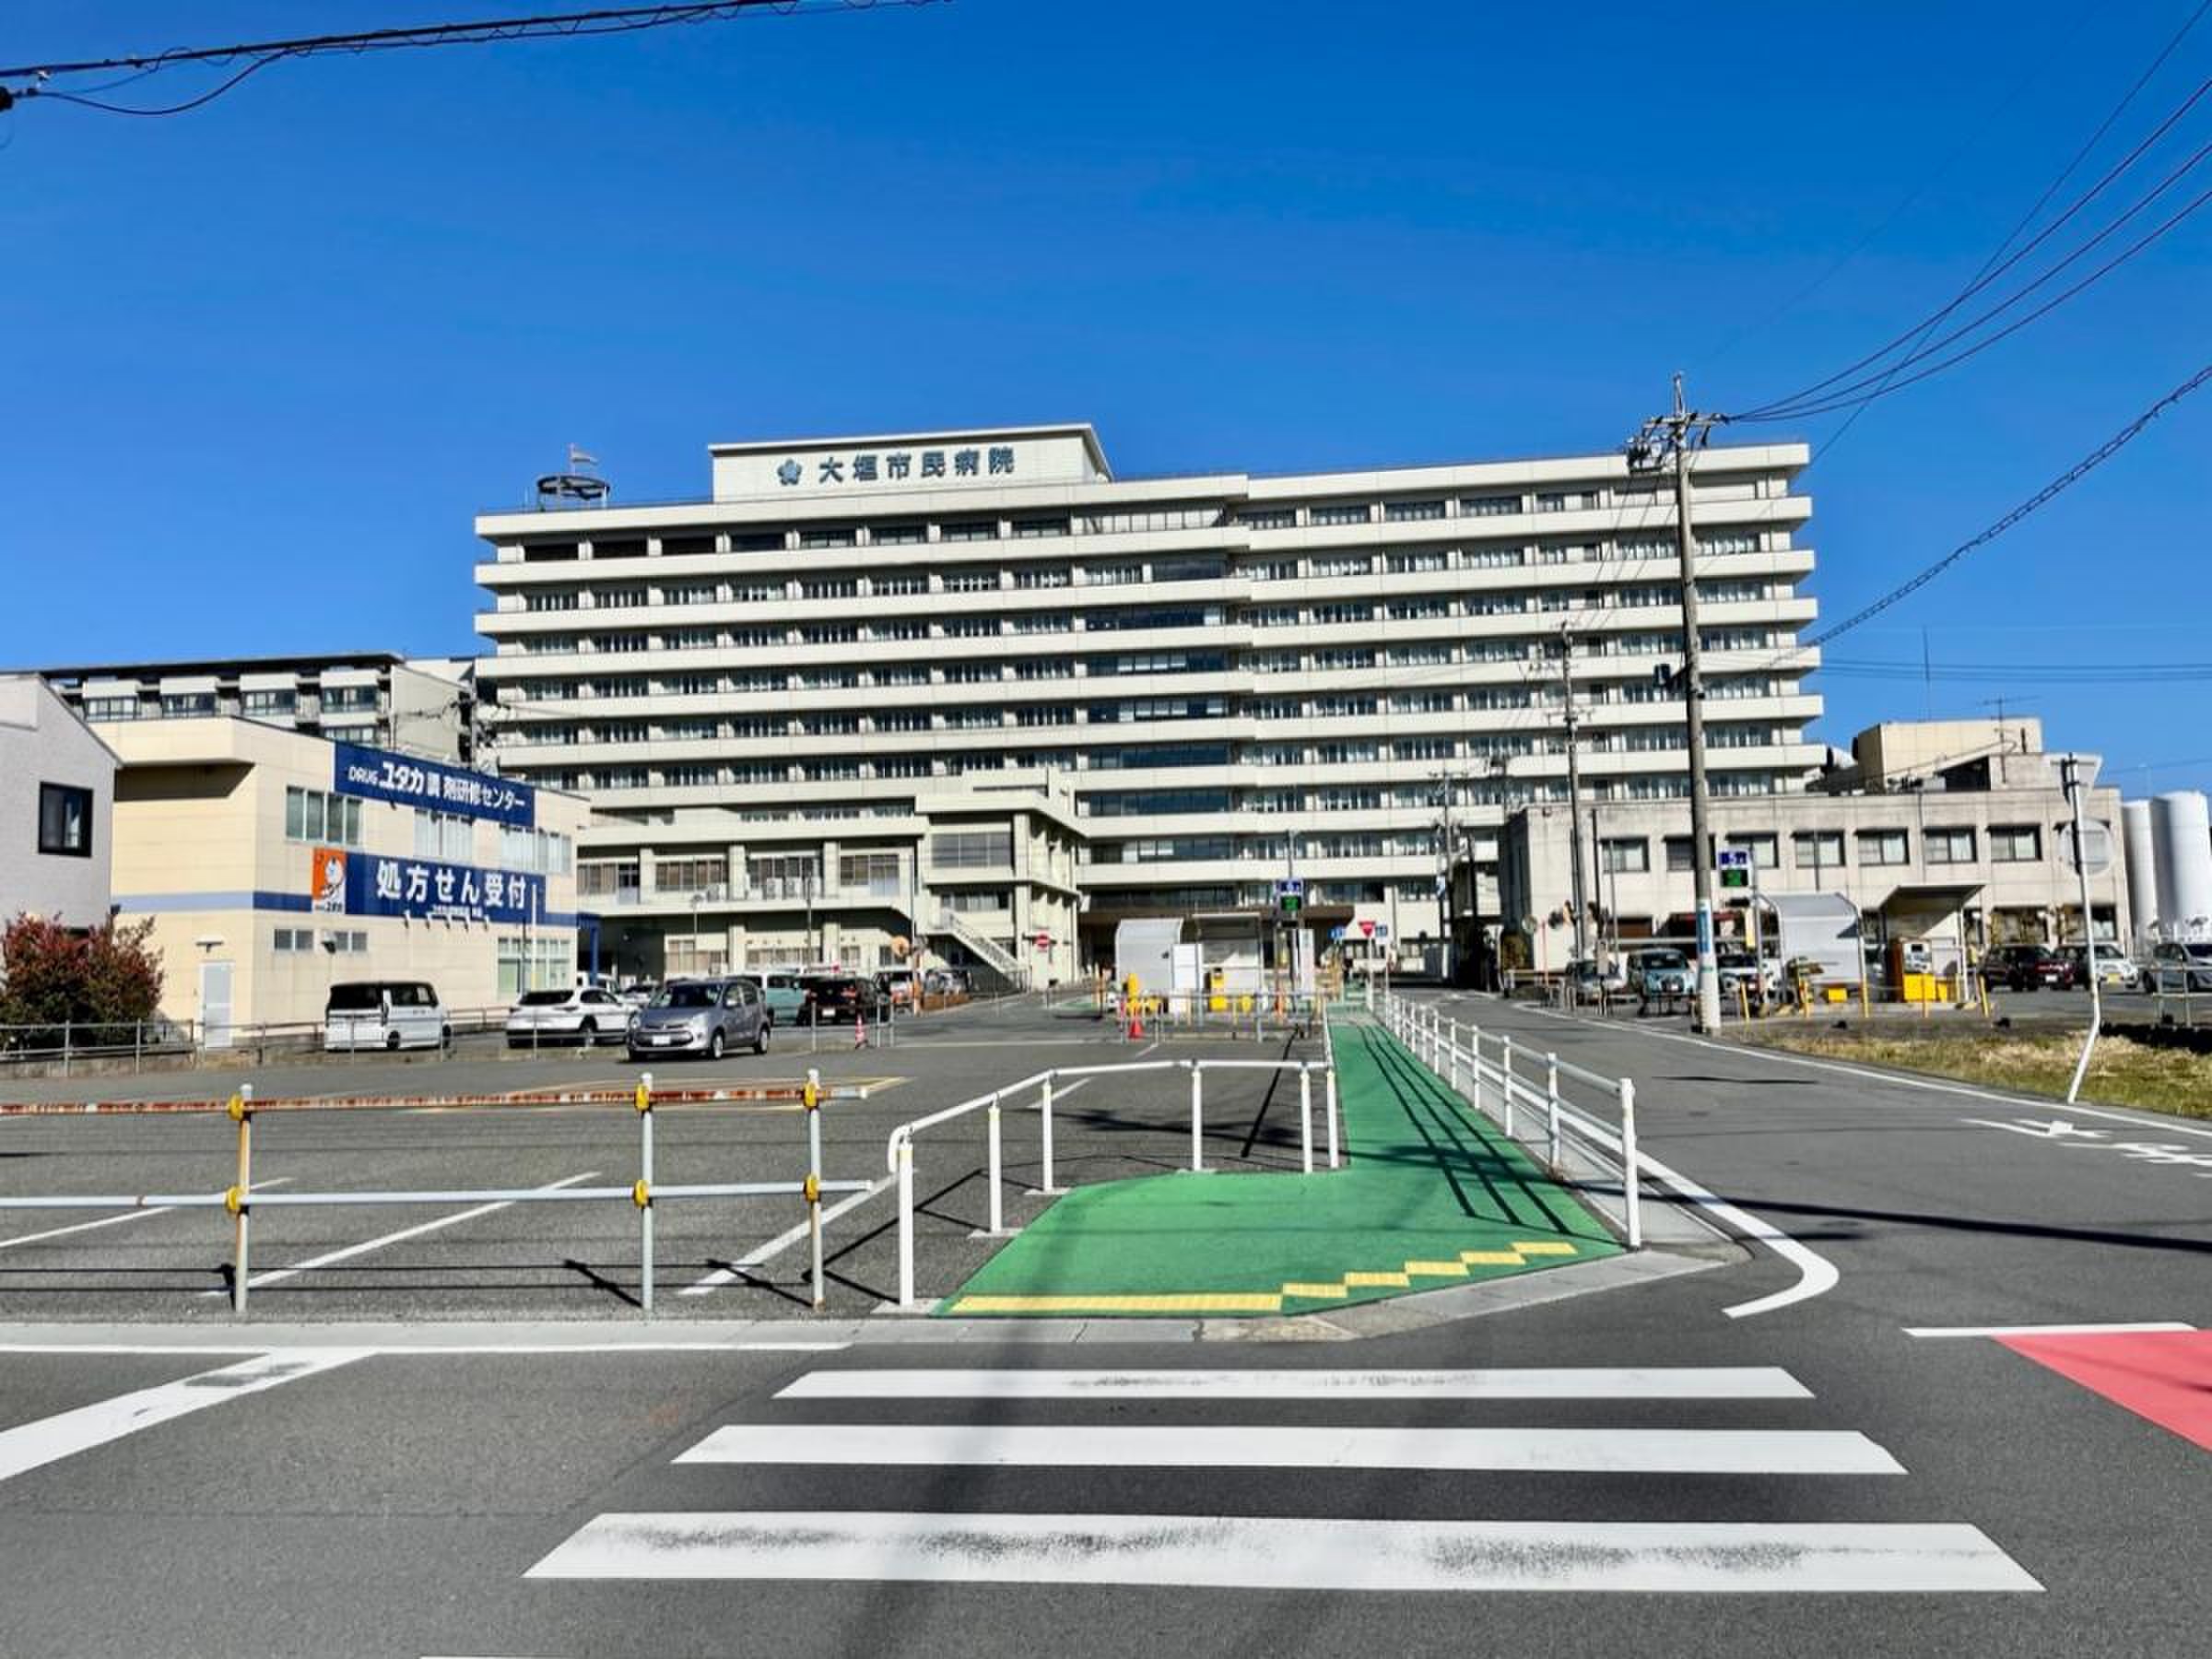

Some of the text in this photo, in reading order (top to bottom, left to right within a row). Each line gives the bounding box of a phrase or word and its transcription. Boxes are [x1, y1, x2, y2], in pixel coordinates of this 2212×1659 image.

[818, 446, 1015, 484] 大垣市民病院
[376, 860, 526, 910] 処方せん受付
